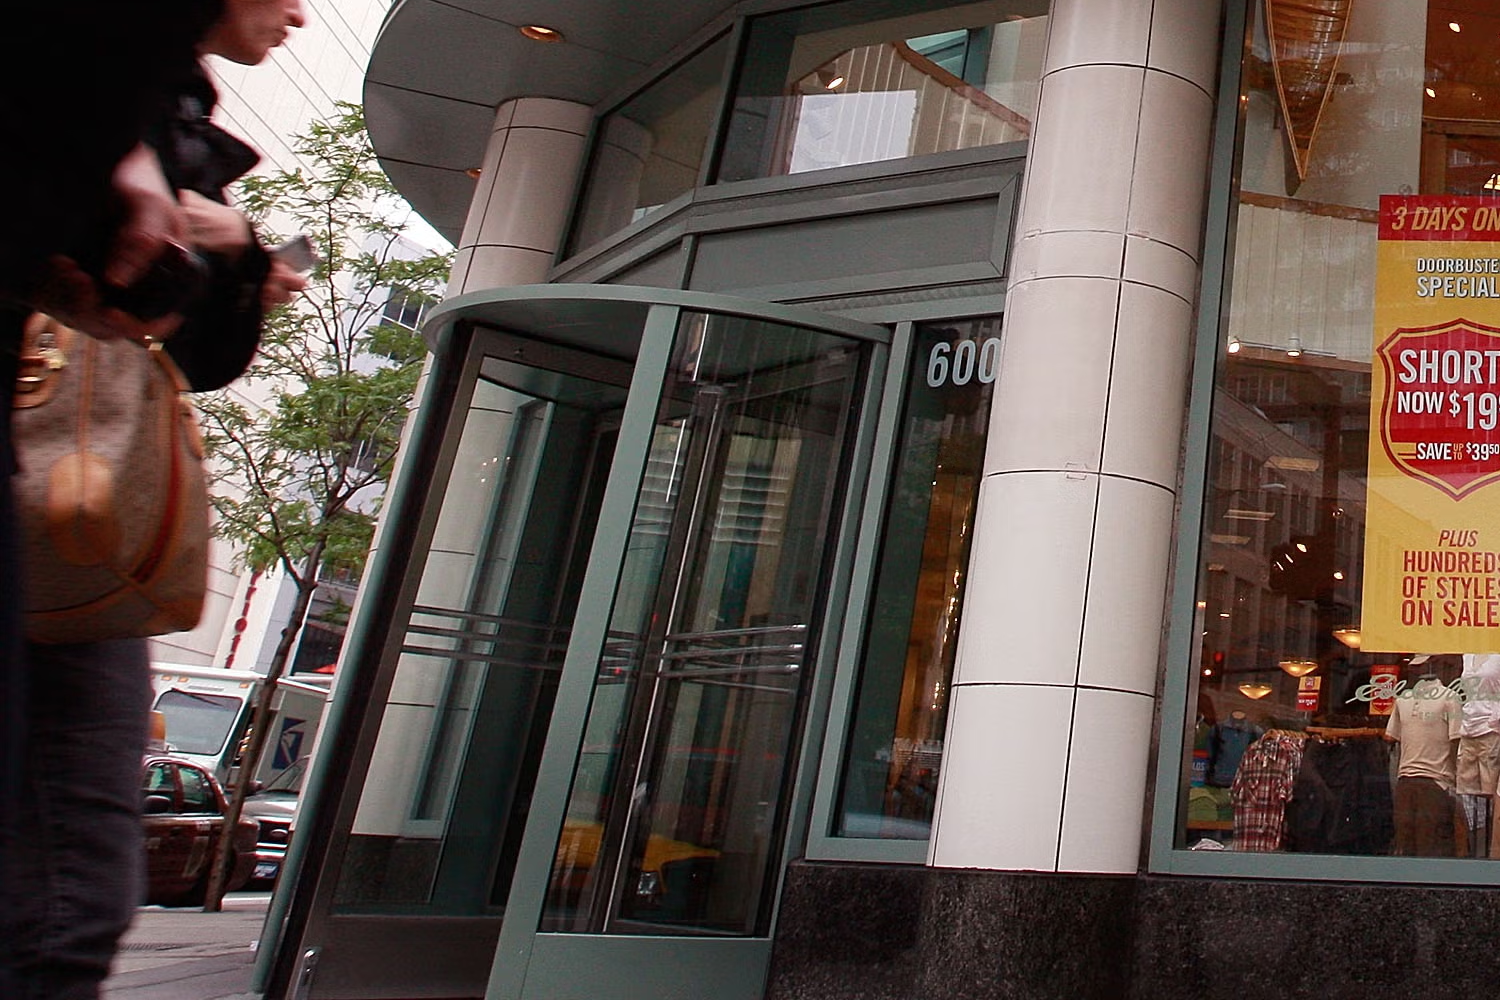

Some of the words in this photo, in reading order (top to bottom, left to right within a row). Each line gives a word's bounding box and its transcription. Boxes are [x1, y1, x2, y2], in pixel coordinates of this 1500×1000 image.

[1391, 206, 1408, 231] 3
[1411, 206, 1468, 232] DAYS
[927, 337, 1001, 388] 600
[1397, 391, 1444, 414] NOW
[1417, 442, 1452, 460] SAVE
[1453, 443, 1464, 452] UP
[1453, 452, 1463, 460] TO
[1438, 530, 1478, 547] PLUS
[1402, 576, 1428, 599] OF
[1401, 600, 1432, 626] ON
